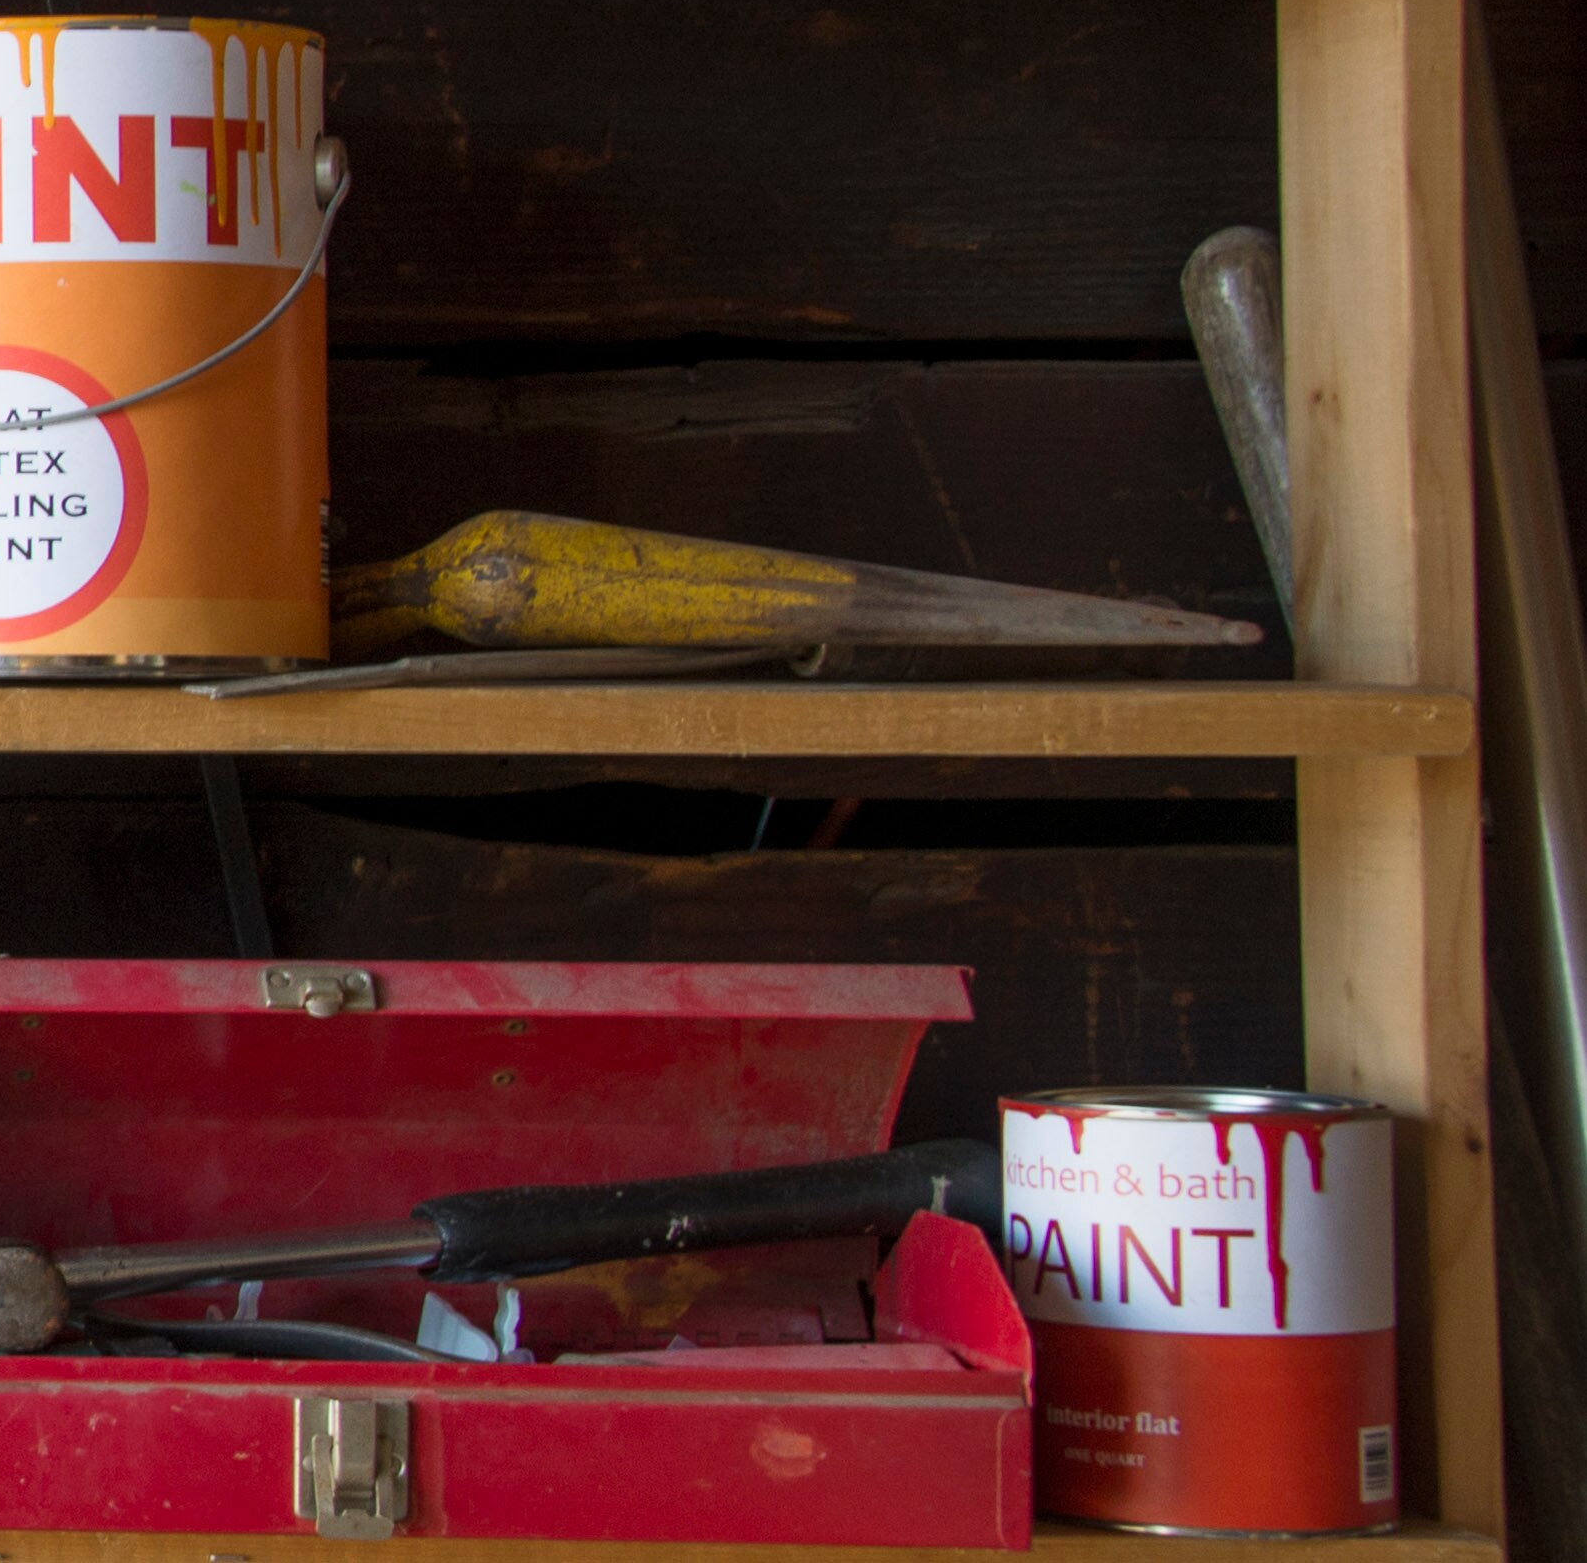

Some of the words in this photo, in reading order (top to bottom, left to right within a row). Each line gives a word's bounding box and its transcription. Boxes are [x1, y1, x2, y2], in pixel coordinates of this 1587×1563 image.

[1006, 1152, 1100, 1193] kitchen
[1113, 1163, 1144, 1197] &
[1159, 1163, 1256, 1200] bath
[1010, 1213, 1255, 1309] PAINT
[1046, 1403, 1130, 1432] interior
[1135, 1411, 1181, 1435] flat
